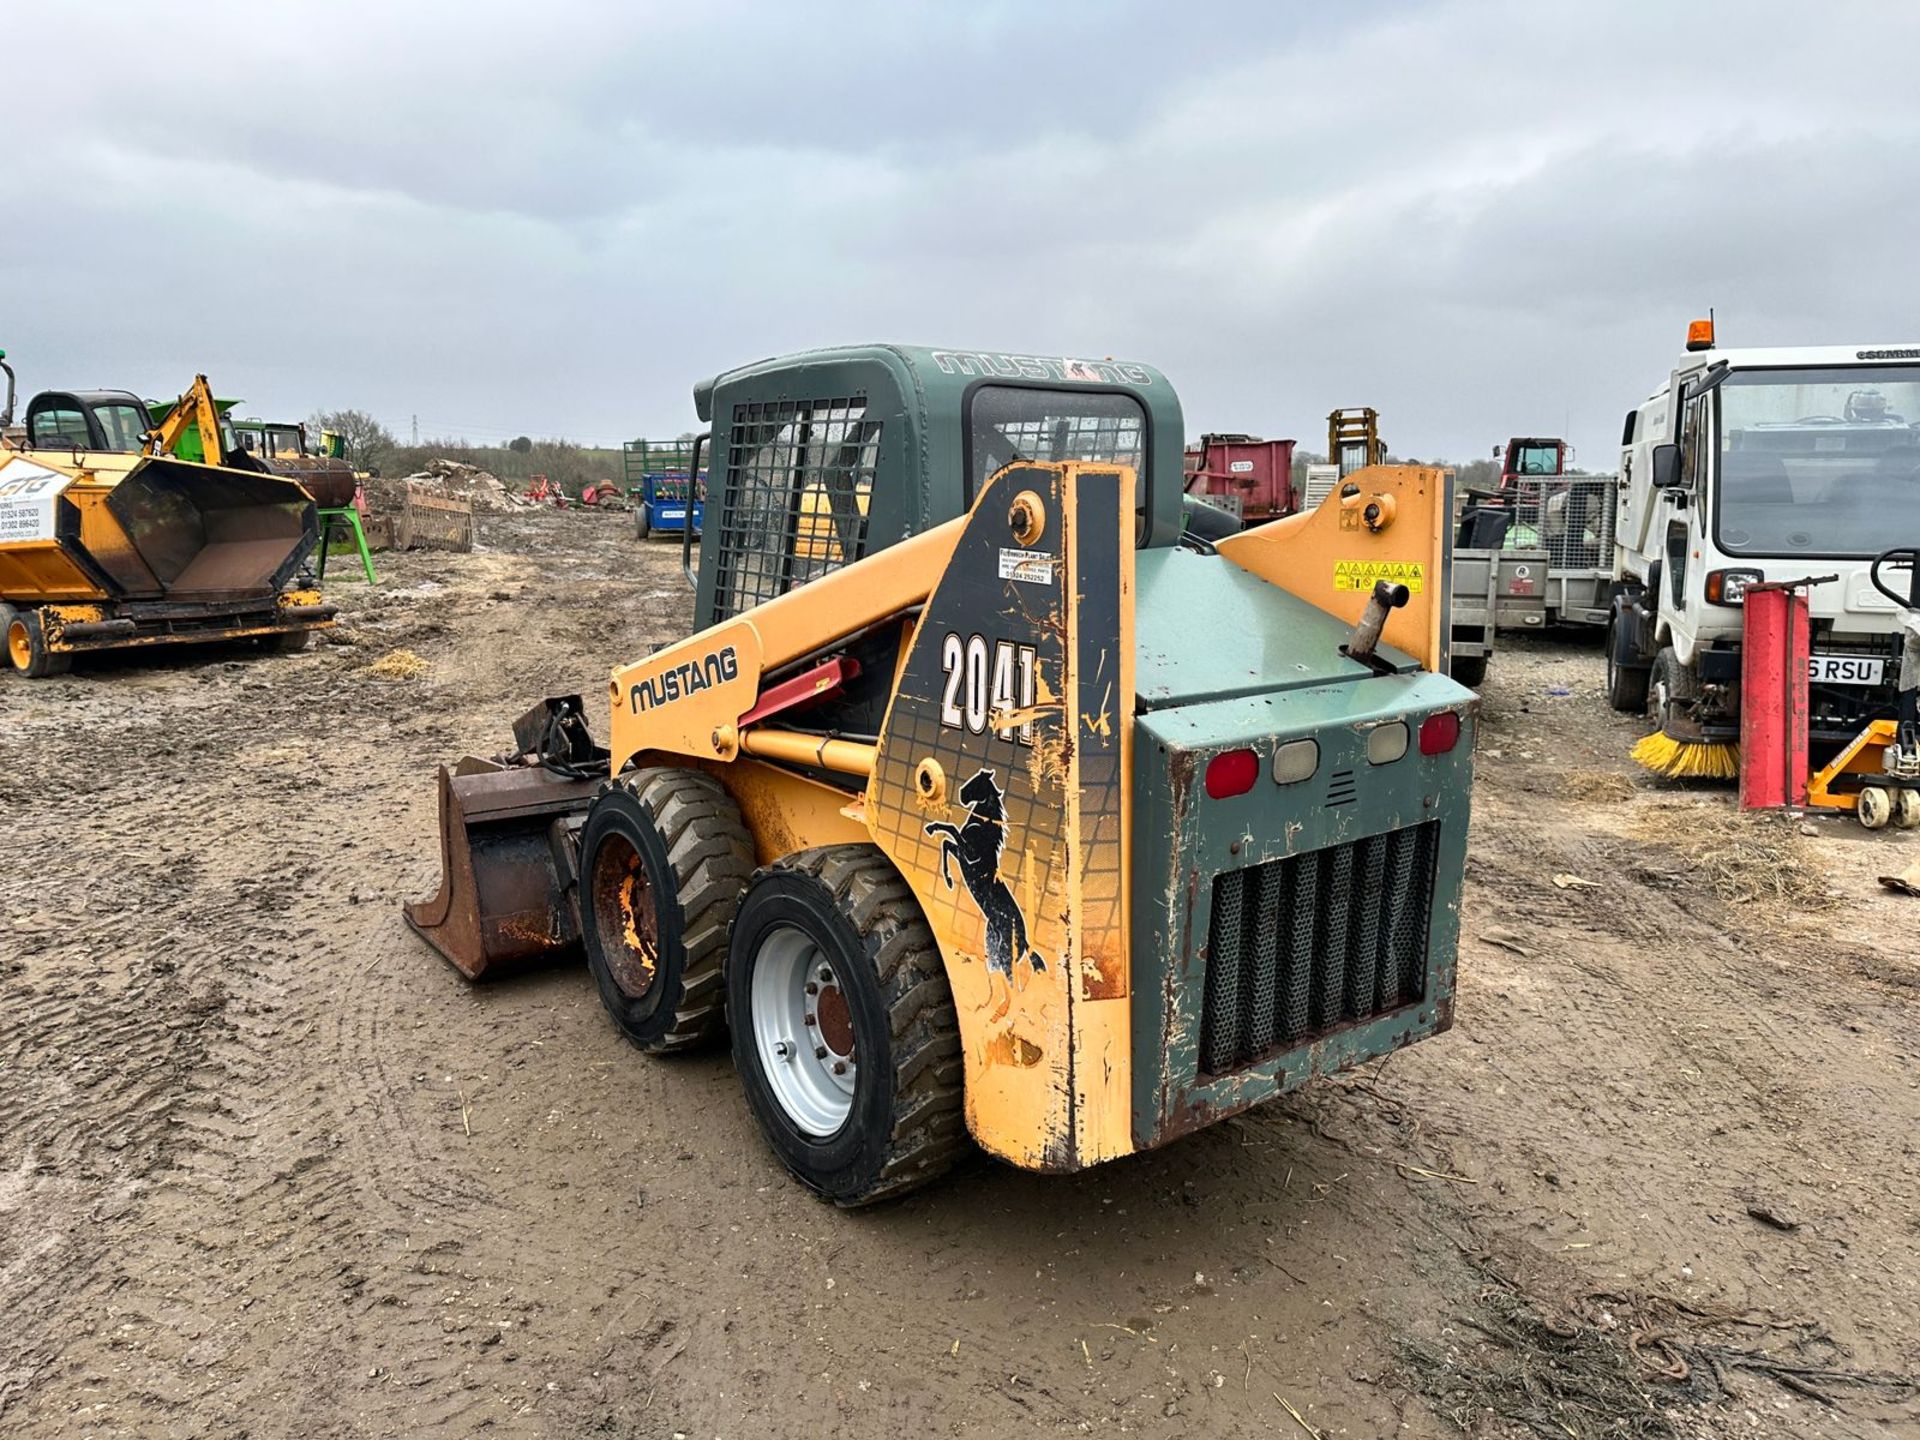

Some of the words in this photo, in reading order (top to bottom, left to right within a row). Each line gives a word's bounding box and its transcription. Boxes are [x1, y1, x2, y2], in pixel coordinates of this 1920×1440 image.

[630, 646, 739, 714] MUSTANG
[941, 632, 1036, 746] 2041
[1825, 660, 1872, 680] RSU
